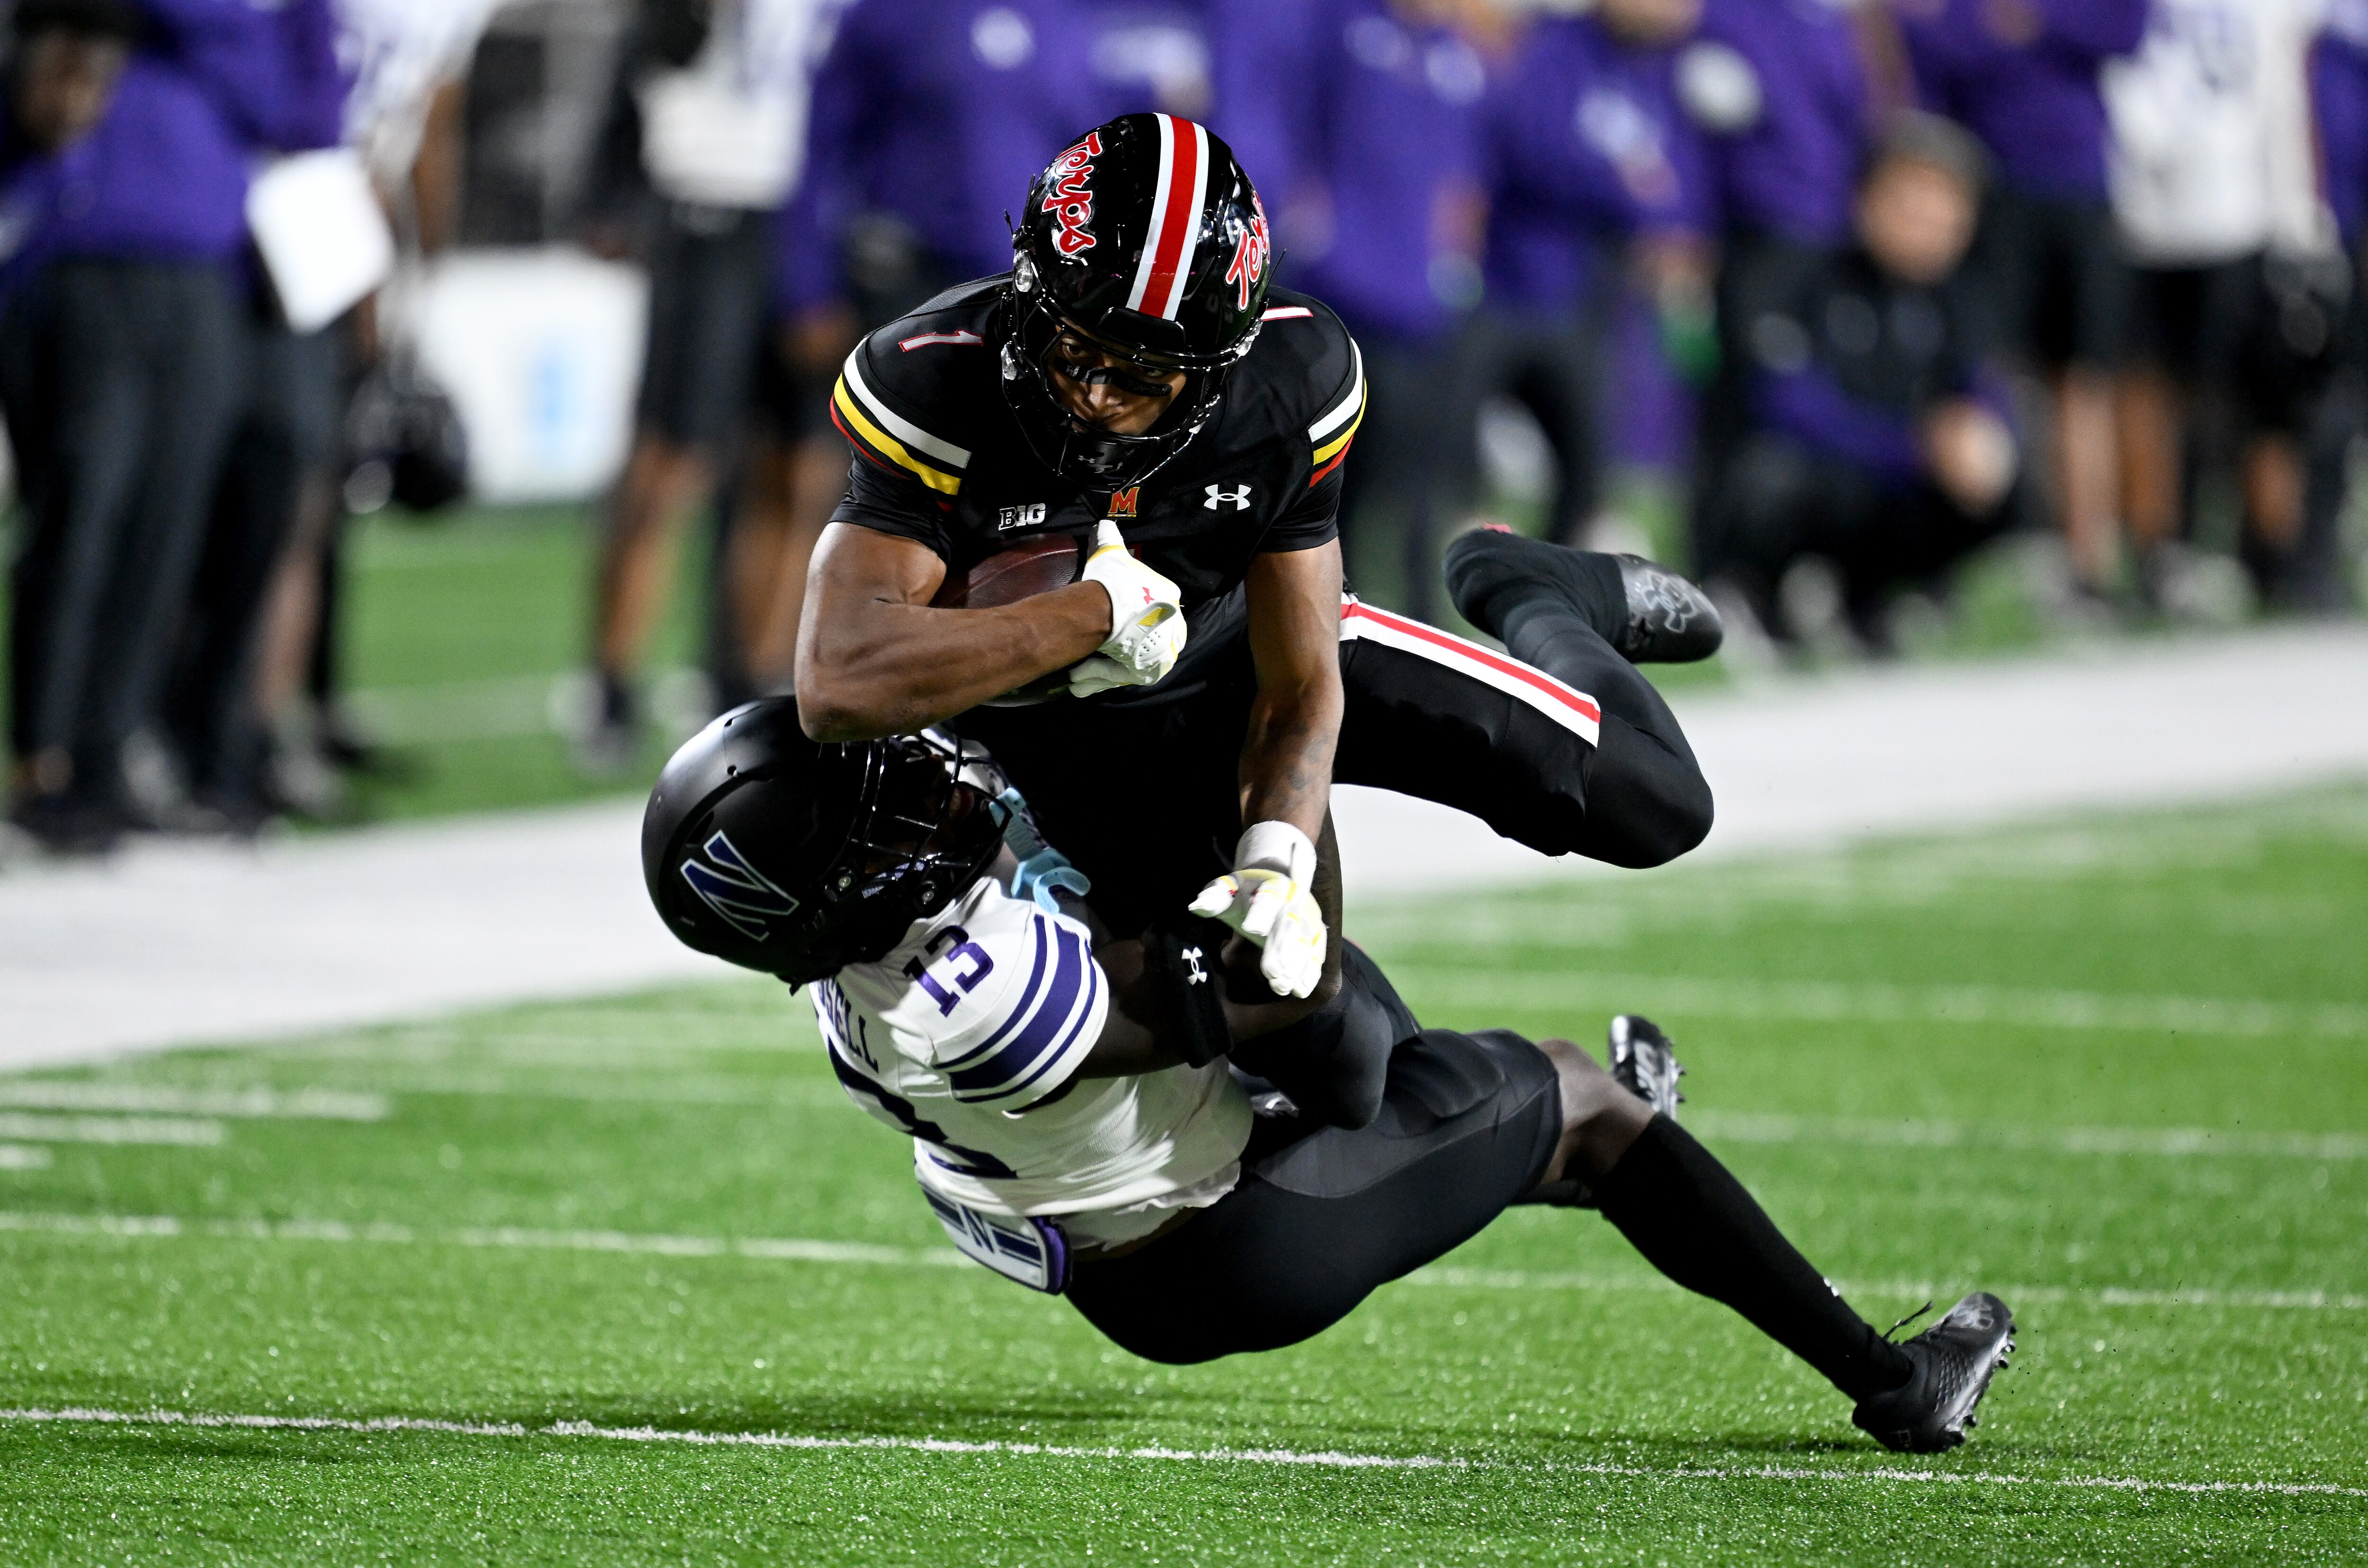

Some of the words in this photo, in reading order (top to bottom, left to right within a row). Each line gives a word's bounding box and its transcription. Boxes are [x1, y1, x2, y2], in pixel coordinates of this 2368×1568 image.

[1042, 132, 1103, 255] Terps
[898, 330, 985, 352] 1
[1107, 487, 1140, 518] M
[680, 829, 800, 941] N
[902, 925, 994, 1018] 13
